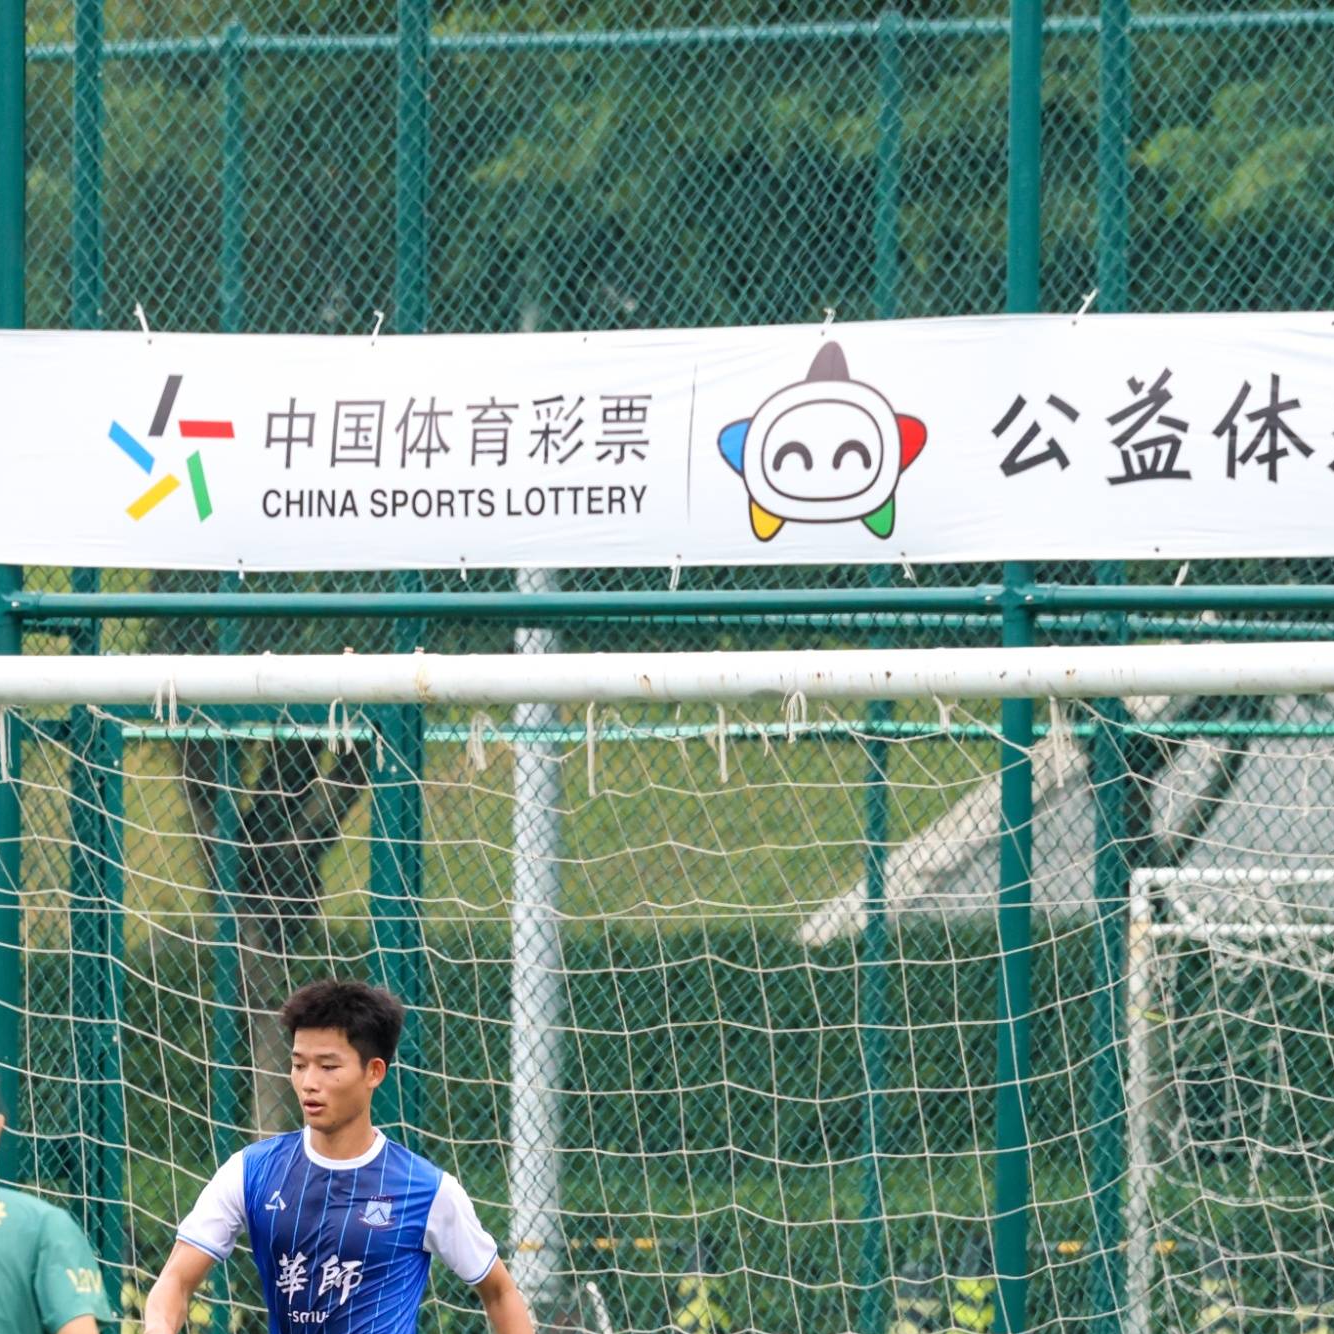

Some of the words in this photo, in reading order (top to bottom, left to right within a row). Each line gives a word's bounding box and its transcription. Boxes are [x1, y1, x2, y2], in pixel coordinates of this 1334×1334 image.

[264, 395, 653, 470] 中国体育彩票
[262, 489, 359, 518] CHINA
[370, 488, 495, 518] SPORTS
[507, 485, 648, 516] LOTTERY
[276, 1251, 363, 1306] 華師
